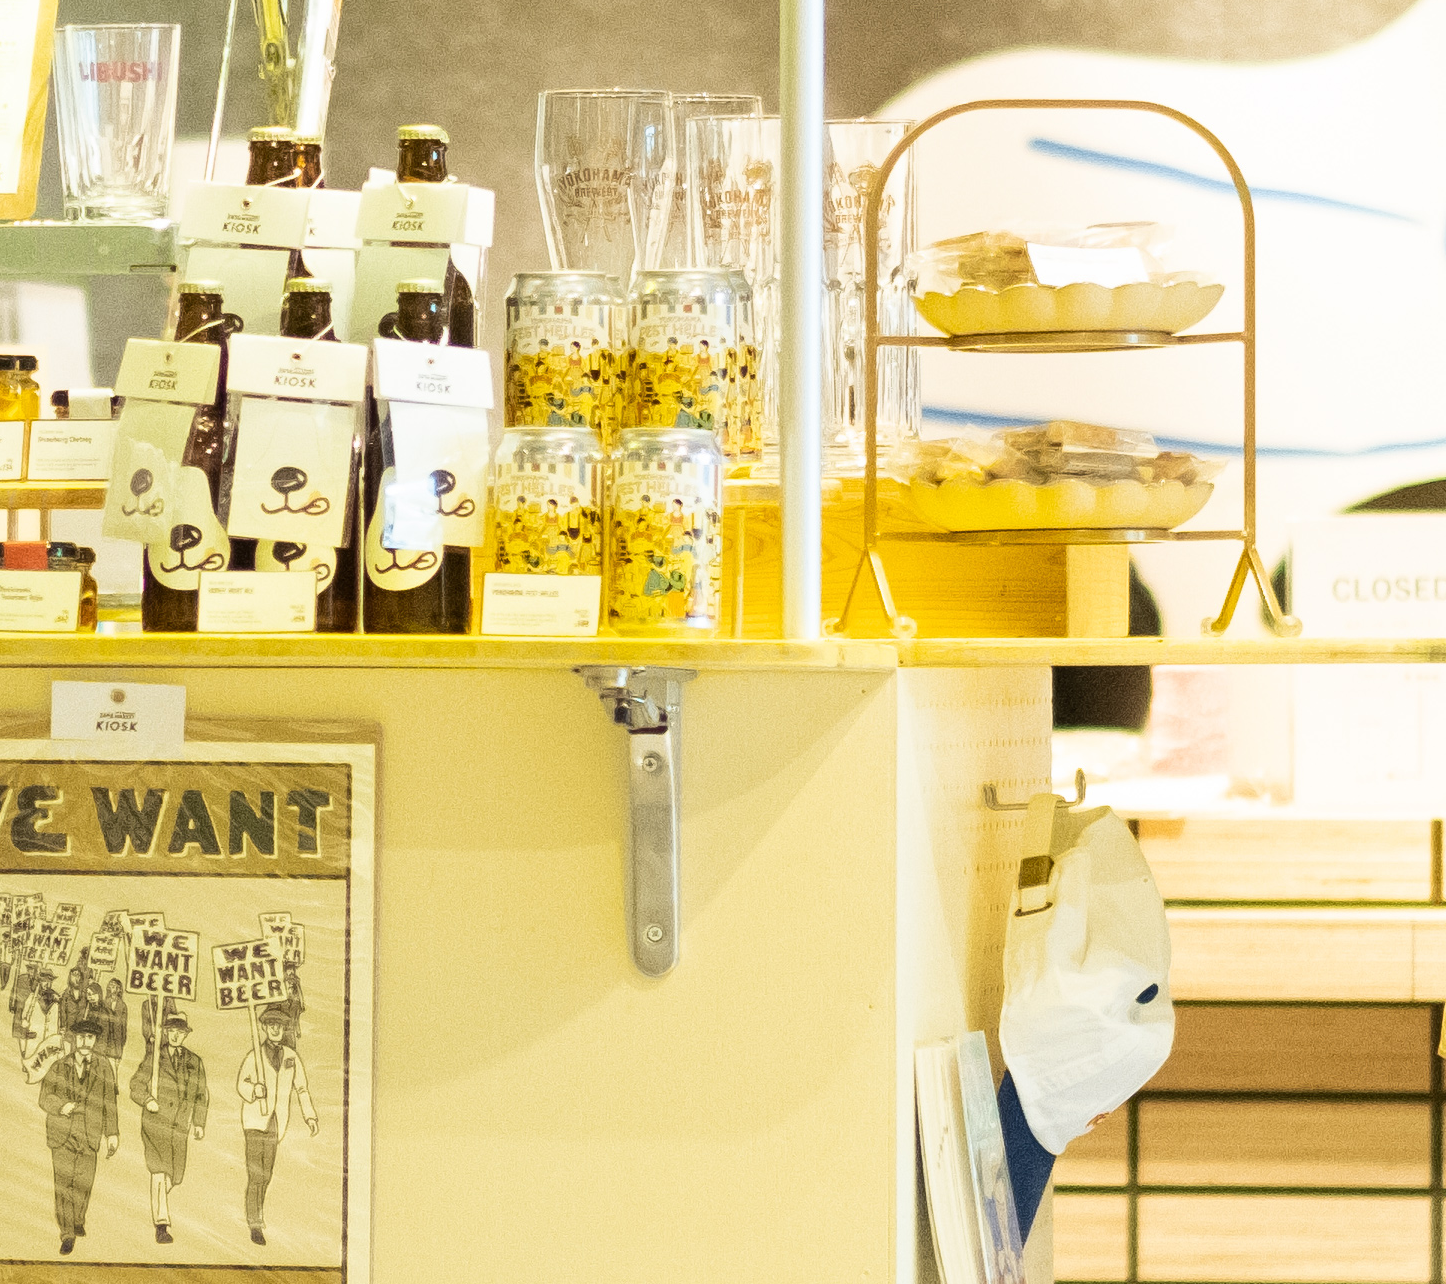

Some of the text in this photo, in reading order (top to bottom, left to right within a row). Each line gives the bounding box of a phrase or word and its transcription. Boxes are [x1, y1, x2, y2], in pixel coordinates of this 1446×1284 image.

[222, 222, 260, 235] KIOSK
[392, 219, 424, 232] KIOSK
[274, 376, 316, 389] KIOSK
[416, 382, 451, 395] KIOSK
[96, 720, 138, 733] KIOSK
[91, 786, 334, 860] WANT
[143, 930, 190, 952] WE
[222, 941, 272, 961] WE
[135, 948, 194, 973] WANT
[218, 959, 277, 983] WANT
[129, 969, 193, 994] BEER
[218, 978, 283, 1010] BEER
